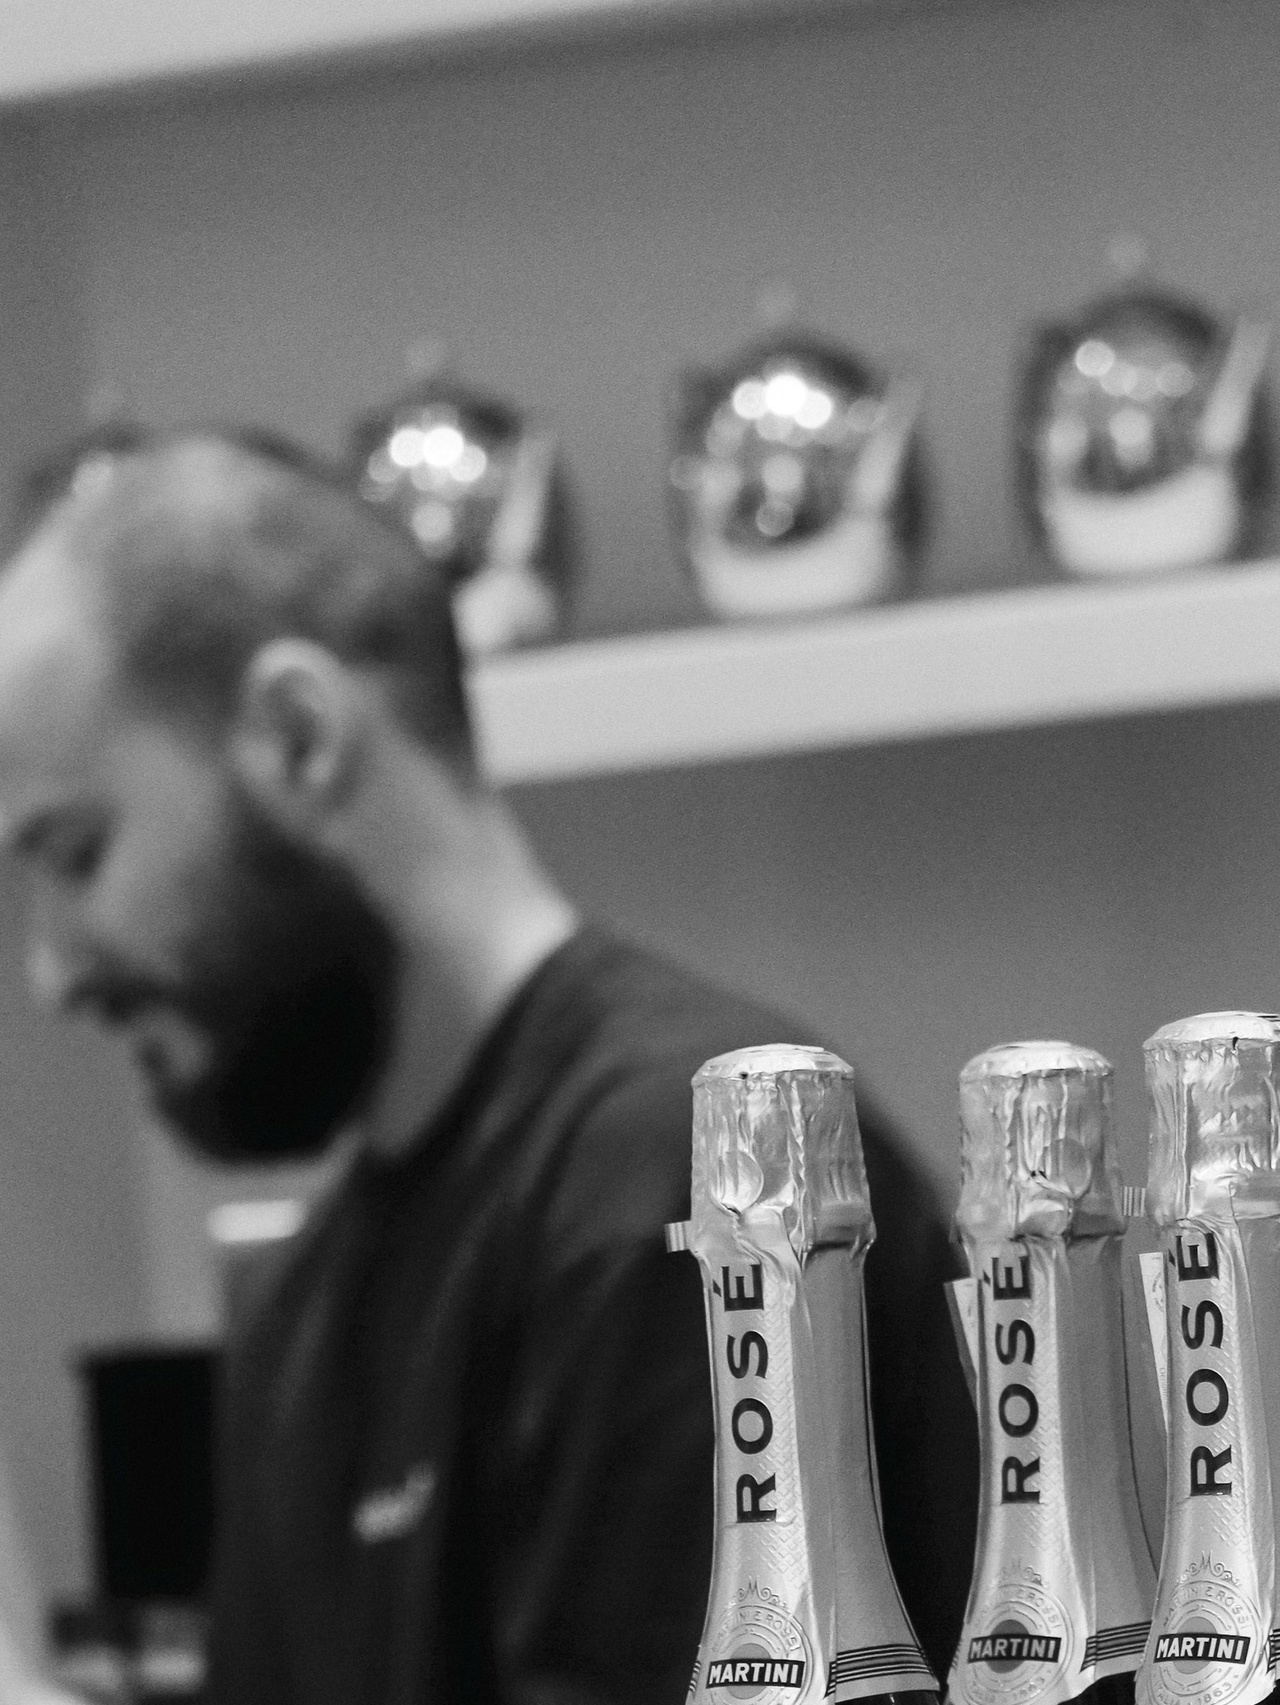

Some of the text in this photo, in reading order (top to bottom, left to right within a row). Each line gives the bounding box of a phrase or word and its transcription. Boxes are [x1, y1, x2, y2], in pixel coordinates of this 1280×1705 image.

[711, 1263, 777, 1523] ROSÉ
[983, 1254, 1041, 1504] ROSÉ
[1169, 1232, 1232, 1497] ROSÉ
[709, 1662, 799, 1685] MARTINI
[970, 1638, 1056, 1660] MARTINI
[1156, 1636, 1245, 1660] MARTINI
